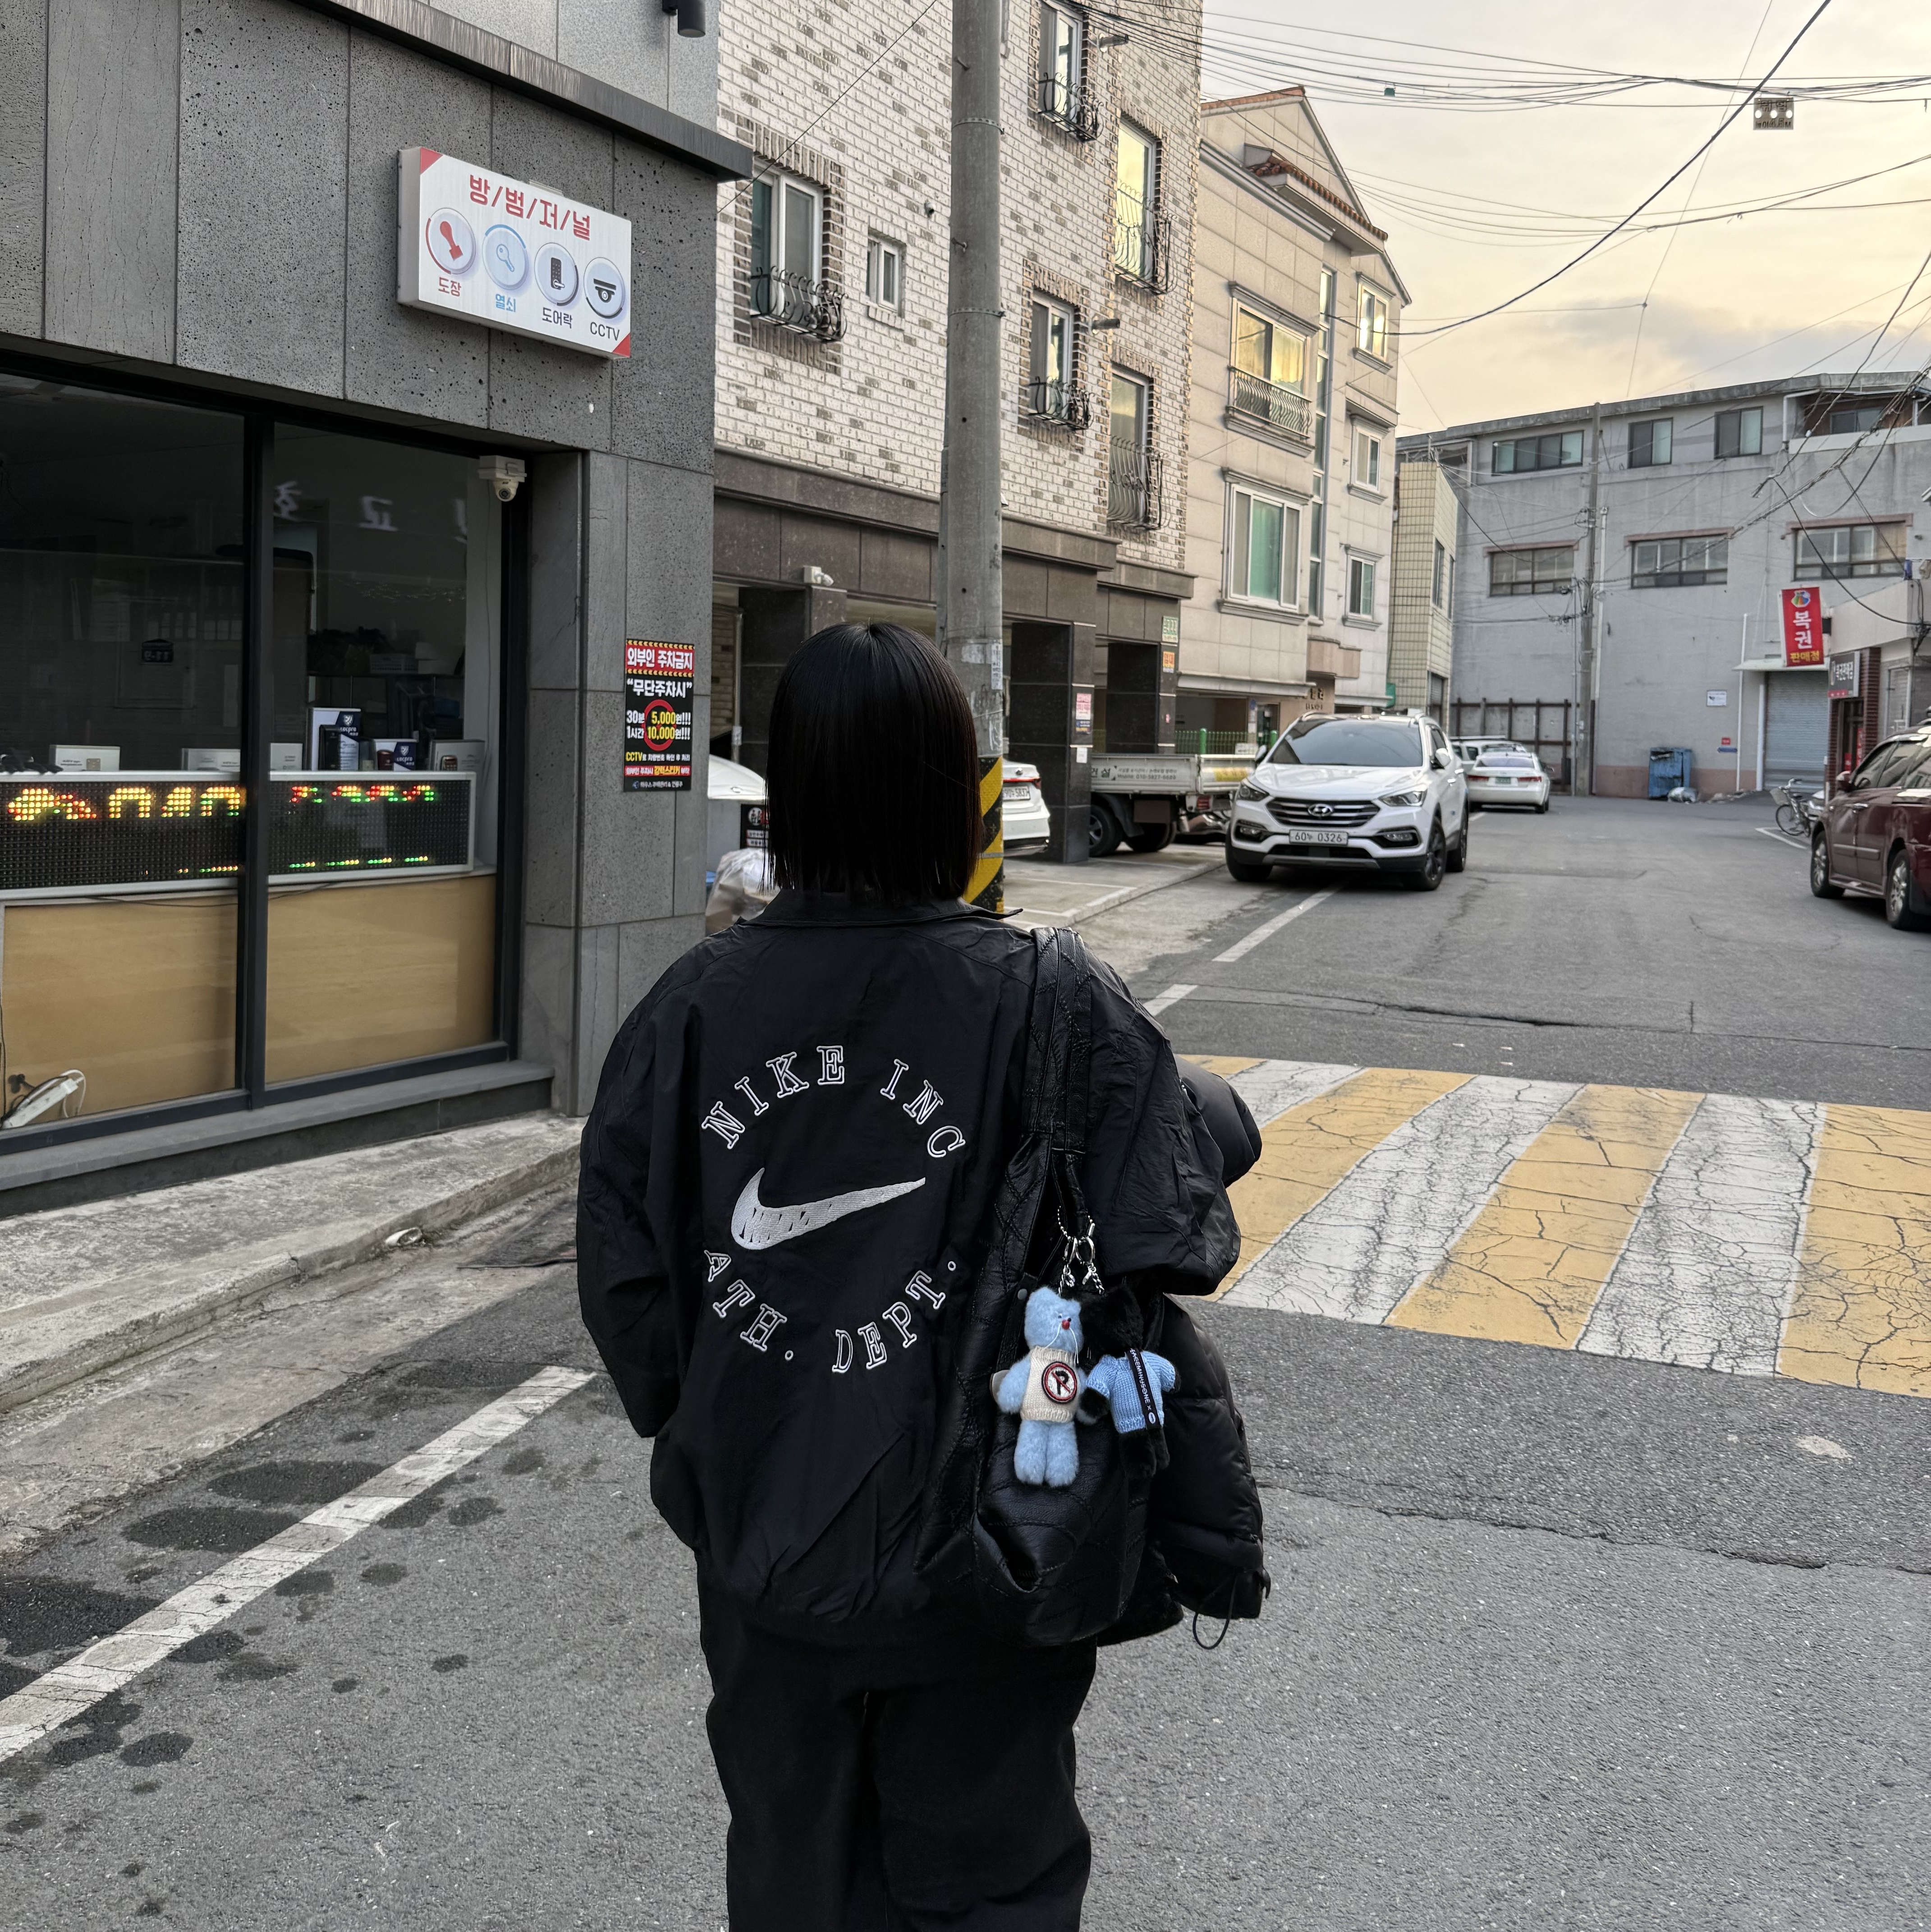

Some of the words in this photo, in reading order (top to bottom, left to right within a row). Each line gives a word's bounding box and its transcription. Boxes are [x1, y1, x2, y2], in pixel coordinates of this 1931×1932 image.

[438, 277, 461, 297] 도장
[495, 294, 516, 312] 열쇠
[542, 307, 573, 329] 도어락
[590, 321, 620, 341] CCTV
[1793, 610, 1812, 649] 복권
[627, 647, 655, 668] 외부인
[657, 650, 693, 670] 주차금지
[1790, 650, 1820, 663] 판매점
[626, 710, 645, 723] 30분
[626, 726, 644, 739] 1시간
[1317, 833, 1342, 842] 0326
[702, 1045, 844, 1149] NIKE
[881, 1059, 965, 1157] INC
[832, 1261, 956, 1373] DEPT.
[1055, 1370, 1069, 1395] P
